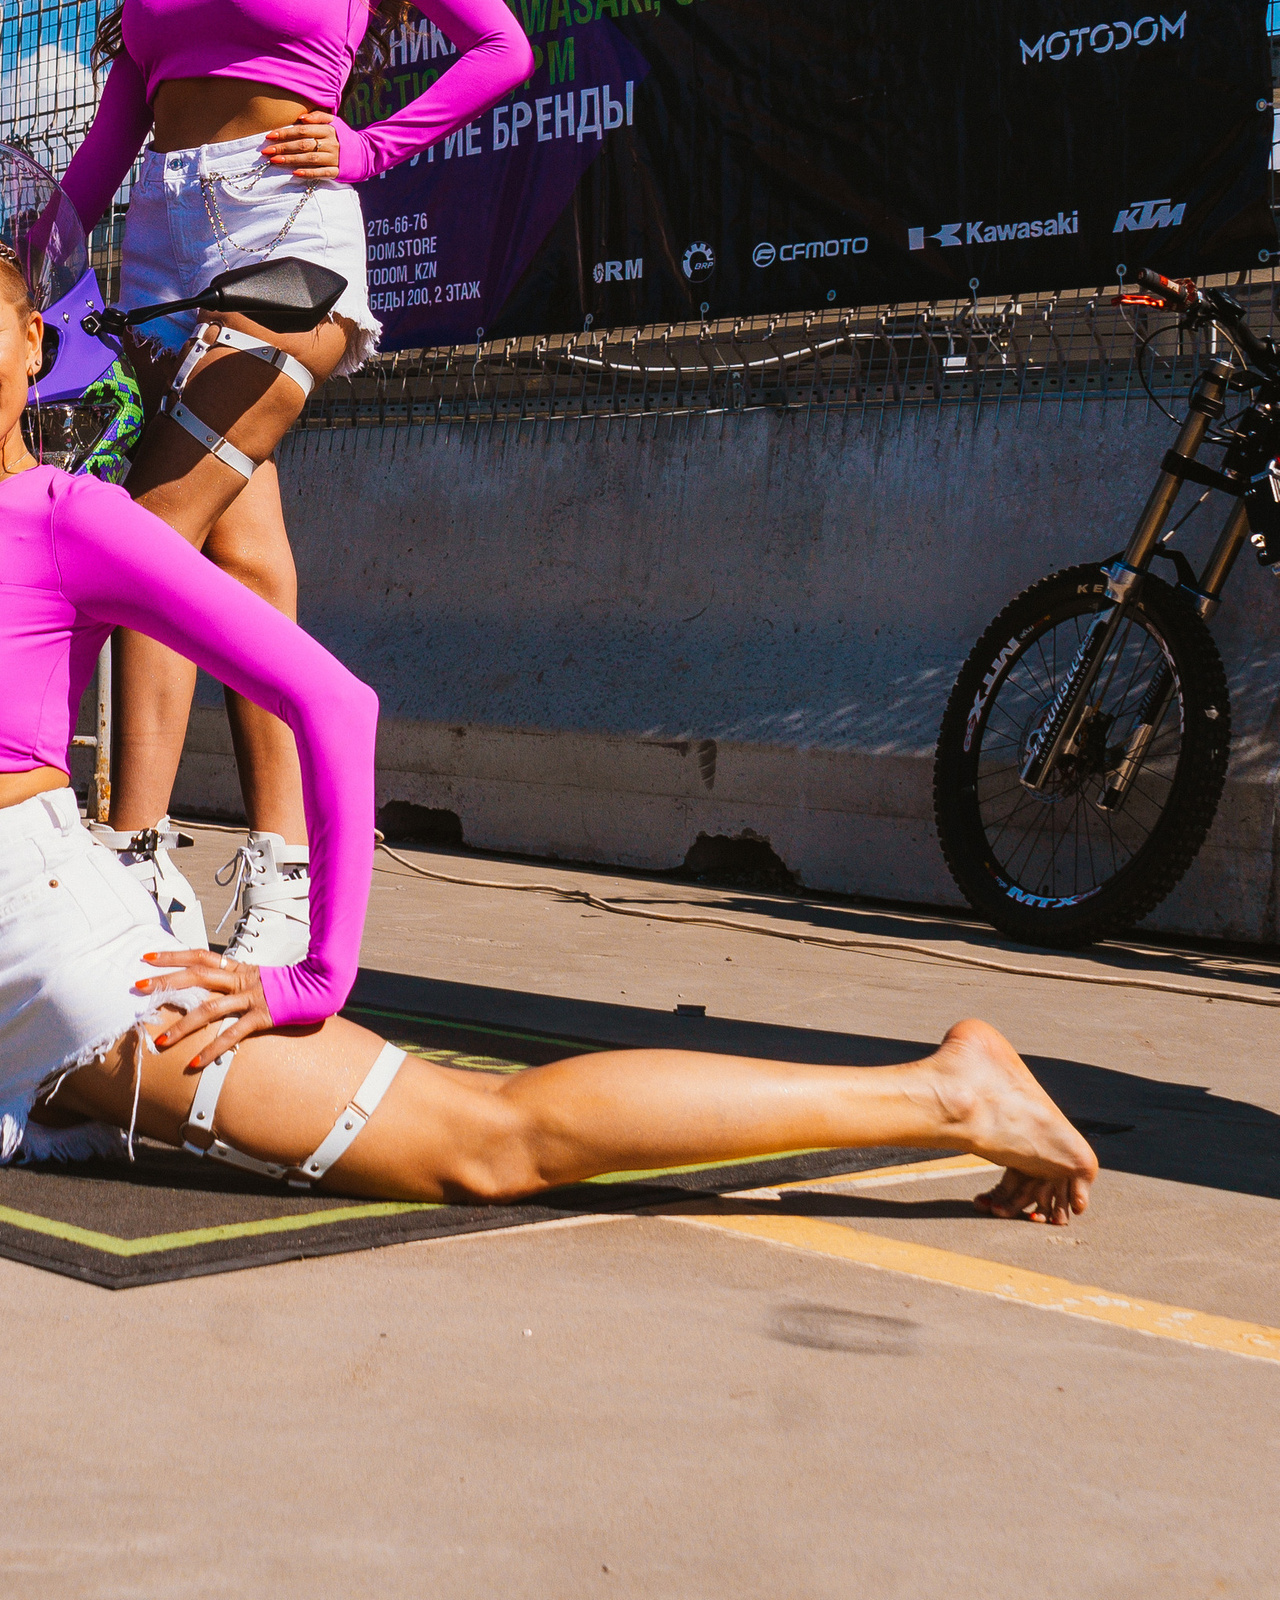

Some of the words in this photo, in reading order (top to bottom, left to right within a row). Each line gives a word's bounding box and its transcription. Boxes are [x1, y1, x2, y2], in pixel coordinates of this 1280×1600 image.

[1019, 10, 1187, 65] MOTODOM
[493, 81, 635, 151] БРЕНДЫ
[367, 212, 428, 238] 276-66-76
[966, 210, 1078, 245] Kawasaki
[1112, 198, 1187, 233] KTM
[779, 236, 869, 262] CFMOTO
[407, 287, 432, 307] 200,
[434, 286, 443, 303] 2
[445, 280, 481, 302] ЭТАЖ
